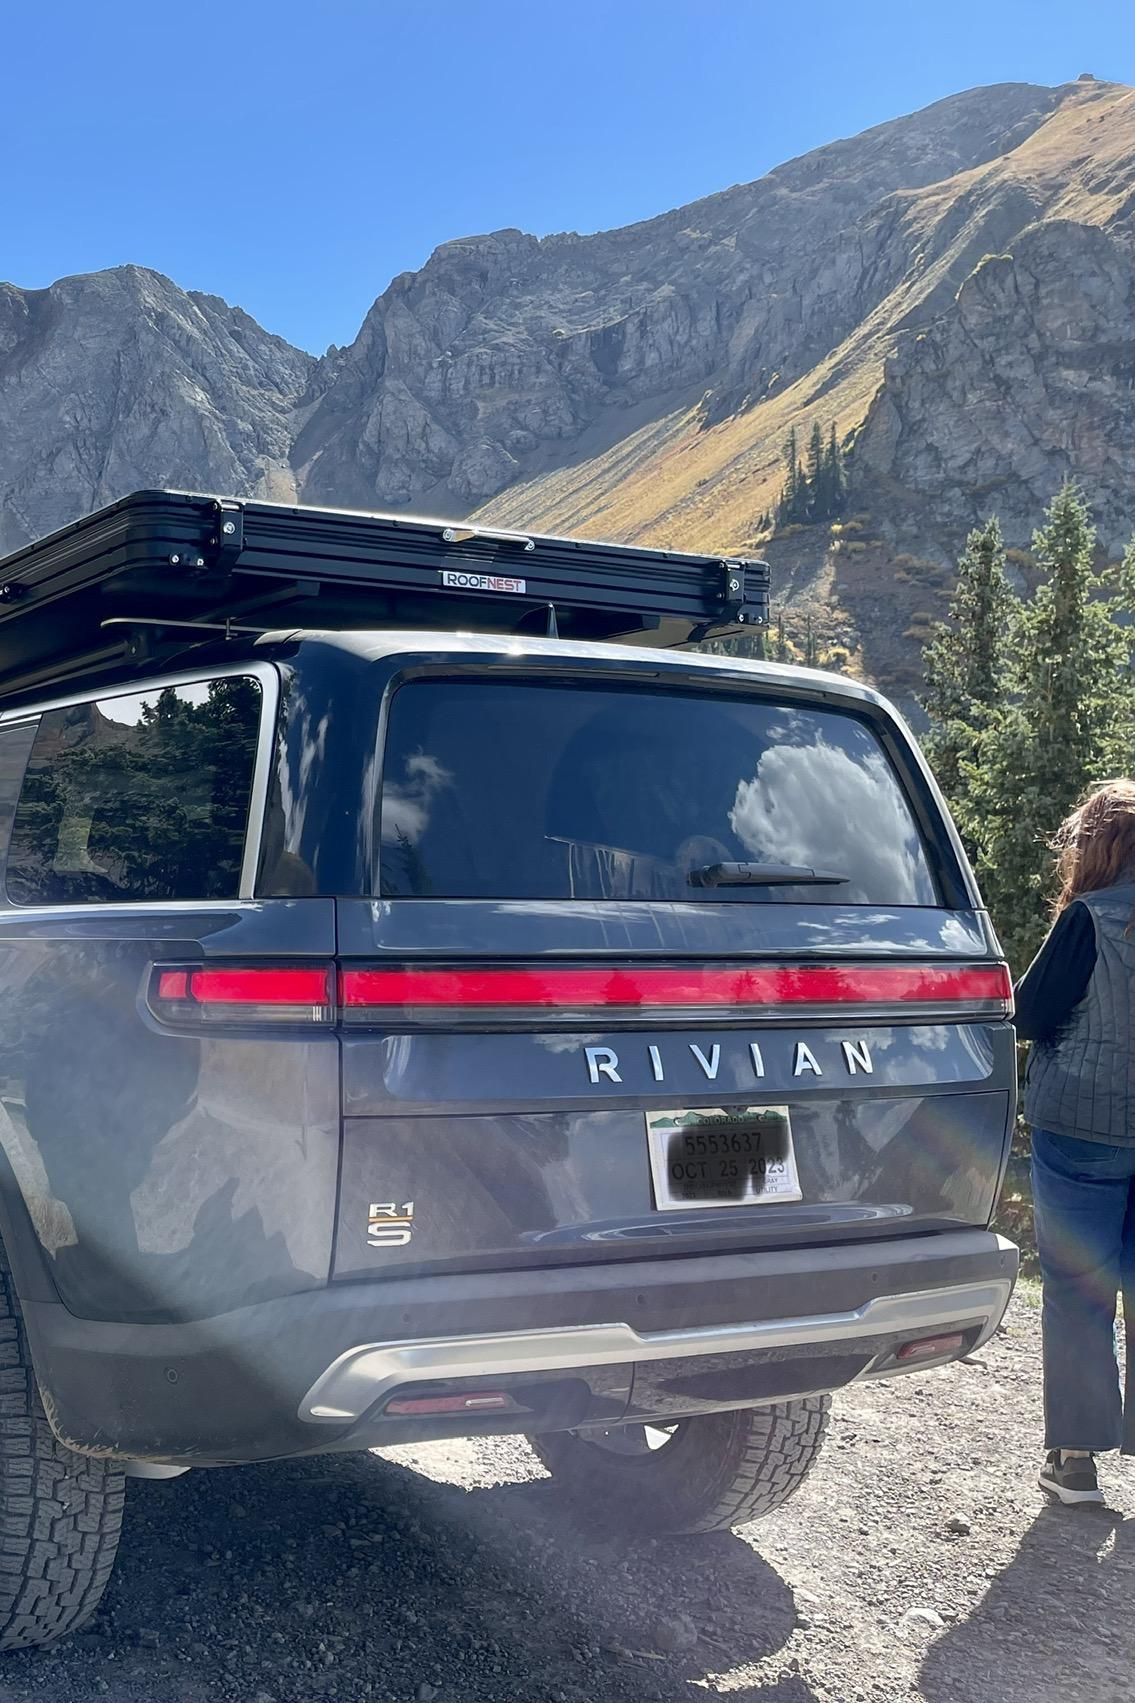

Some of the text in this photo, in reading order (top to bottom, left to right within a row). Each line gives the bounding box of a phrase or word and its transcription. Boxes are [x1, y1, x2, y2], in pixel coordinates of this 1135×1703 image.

[447, 573, 522, 592] ROOFNEST
[584, 1039, 875, 1084] RIVIAN
[696, 1115, 745, 1126] COLORADO
[685, 1132, 761, 1156] 5553637
[671, 1156, 785, 1180] OCT 25 2023
